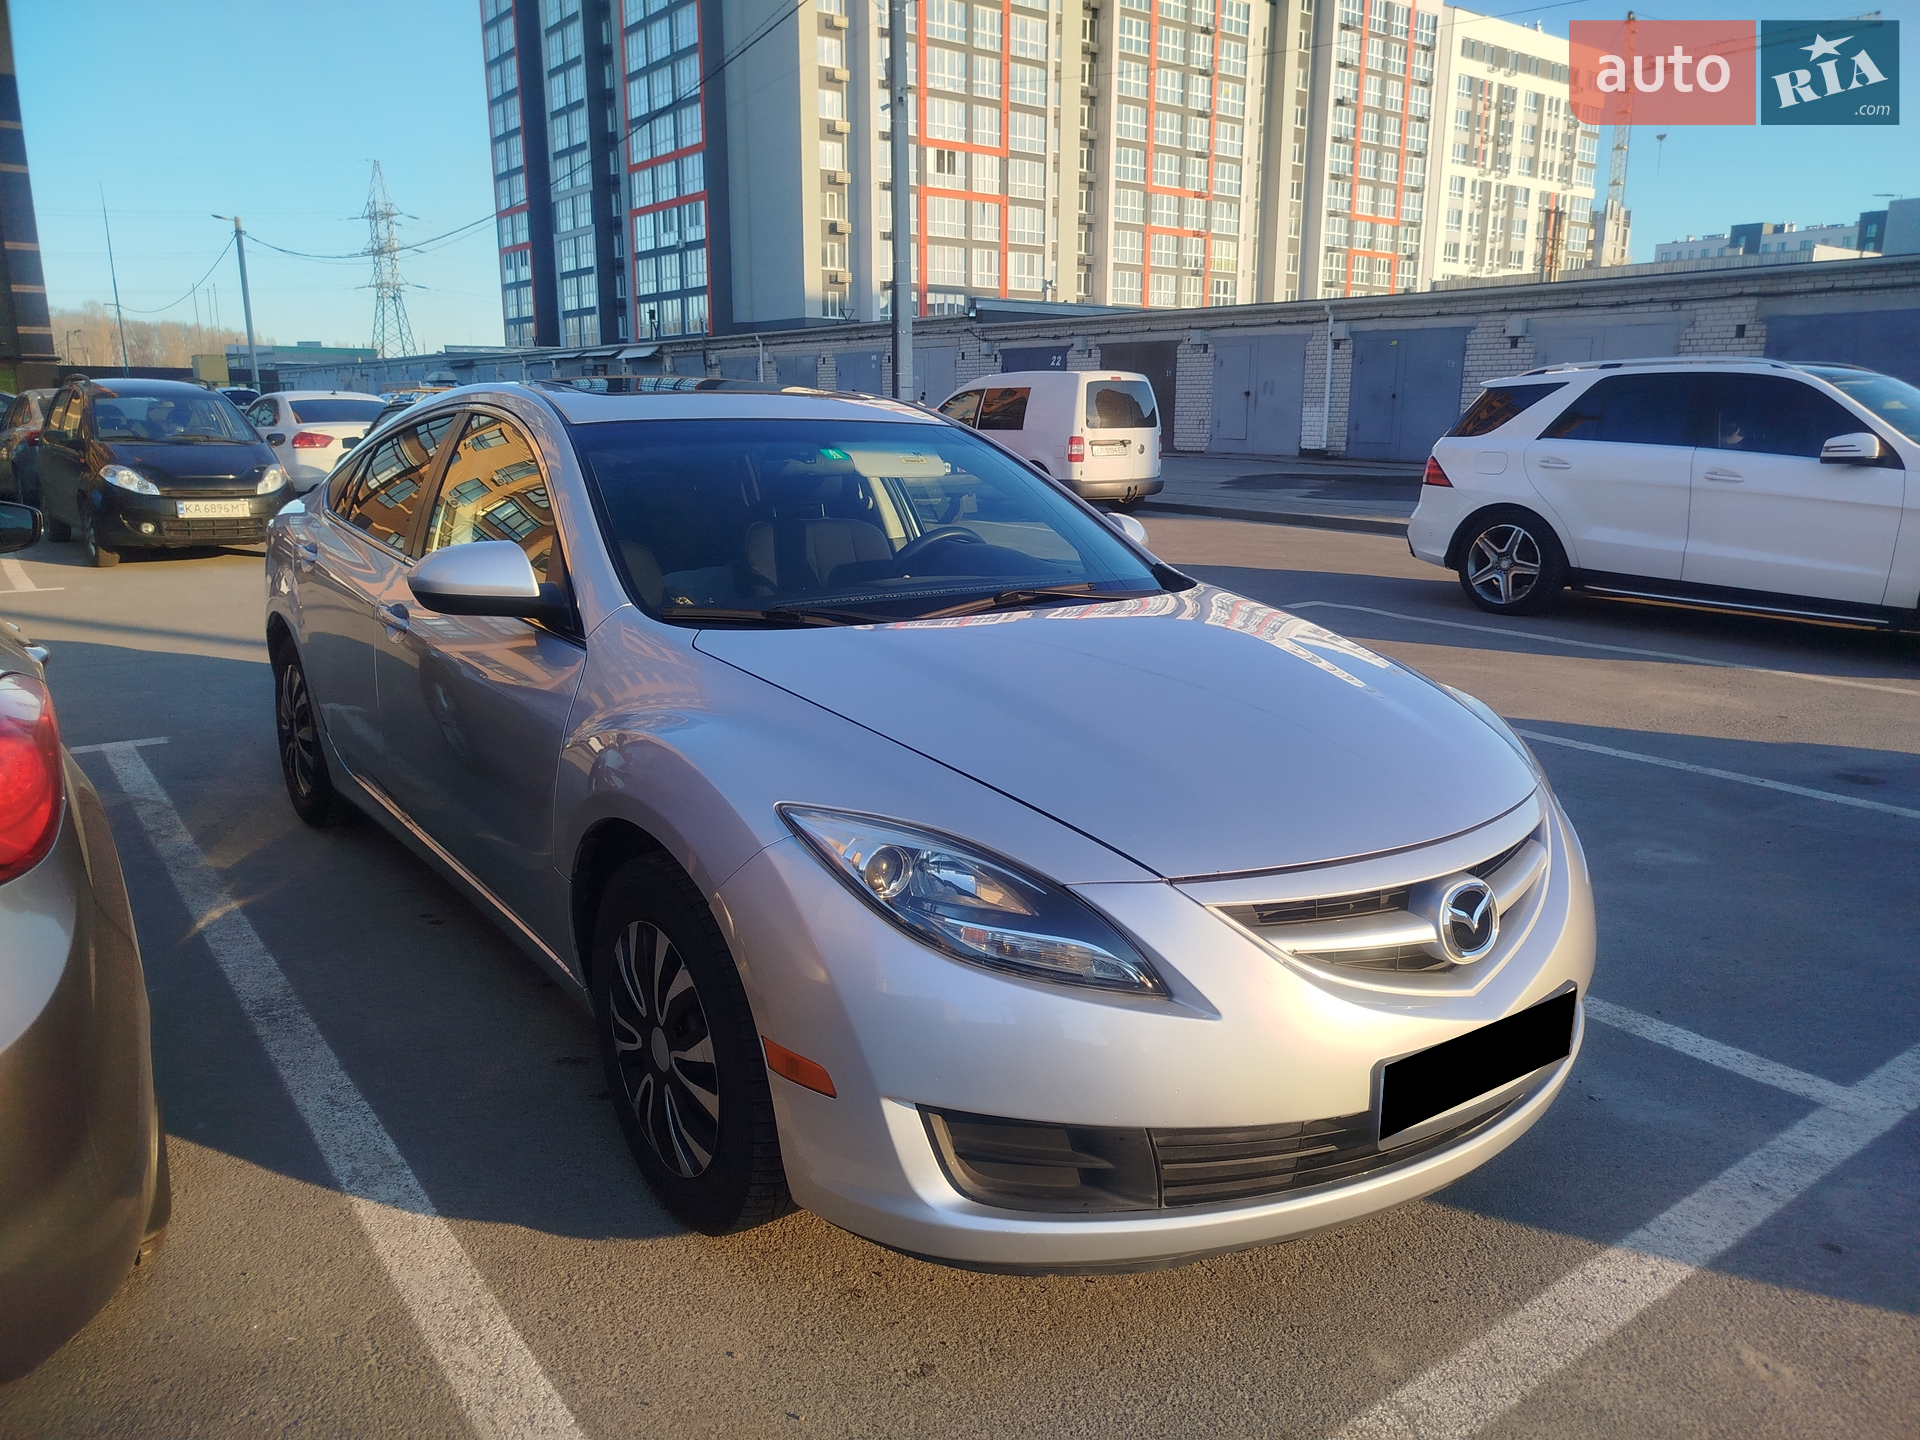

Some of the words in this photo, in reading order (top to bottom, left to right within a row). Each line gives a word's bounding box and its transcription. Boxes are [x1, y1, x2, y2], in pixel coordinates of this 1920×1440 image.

[1050, 355, 1062, 366] 22
[185, 503, 201, 514] KA
[203, 503, 229, 514] 6896
[231, 503, 246, 514] MT
